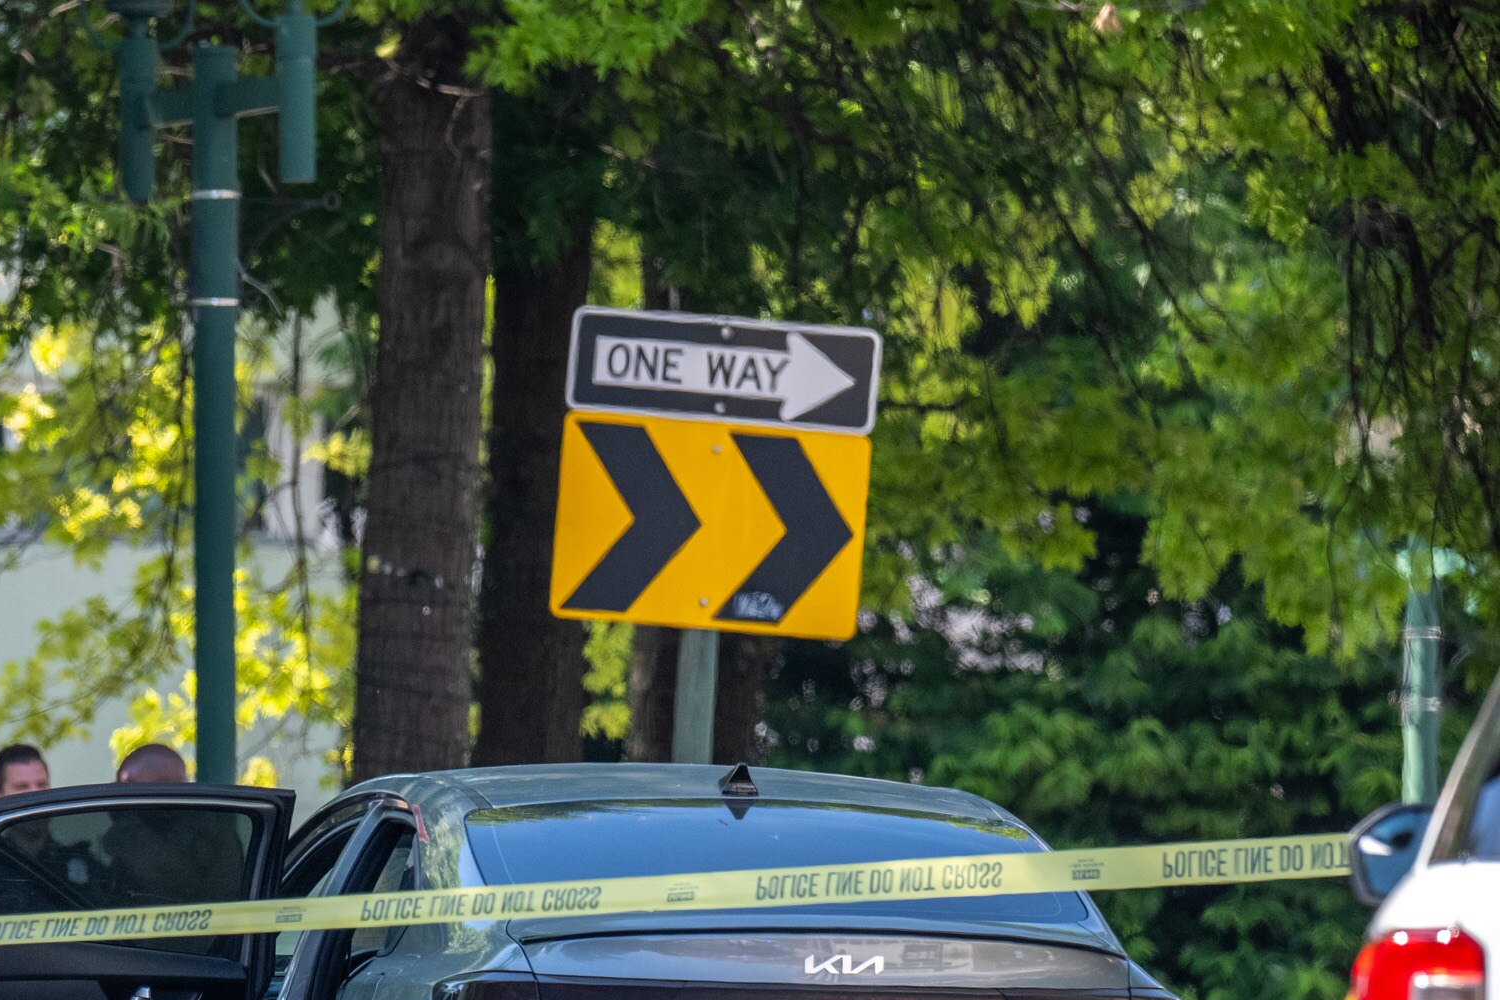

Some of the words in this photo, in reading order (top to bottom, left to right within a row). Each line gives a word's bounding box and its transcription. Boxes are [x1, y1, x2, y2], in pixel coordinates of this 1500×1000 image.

[607, 343, 683, 385] ONE
[707, 351, 790, 393] WAY
[805, 954, 884, 975] KIA
